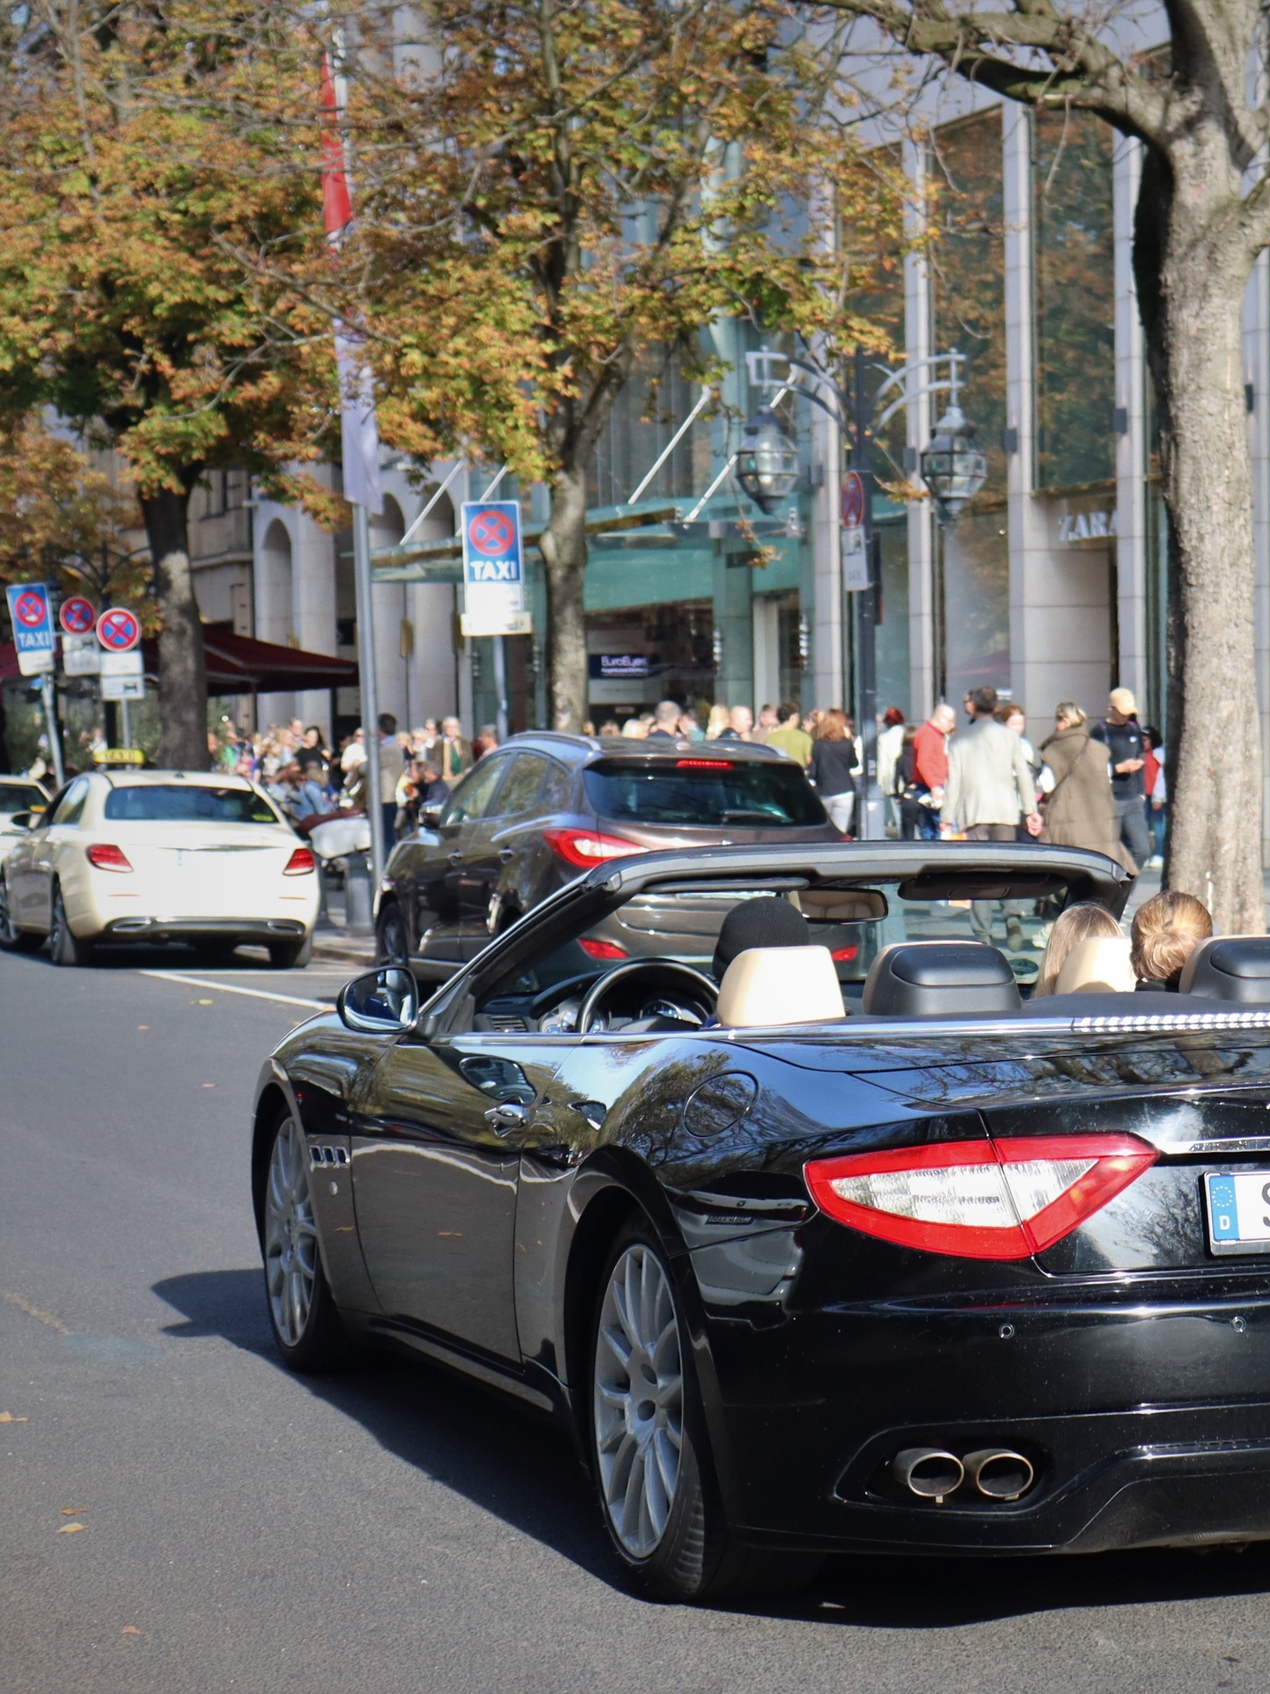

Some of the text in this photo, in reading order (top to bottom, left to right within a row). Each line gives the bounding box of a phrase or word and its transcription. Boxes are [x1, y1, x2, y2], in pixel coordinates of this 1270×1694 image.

[470, 560, 517, 580] TAXI
[18, 631, 49, 648] TAXI
[1219, 1215, 1231, 1230] D
